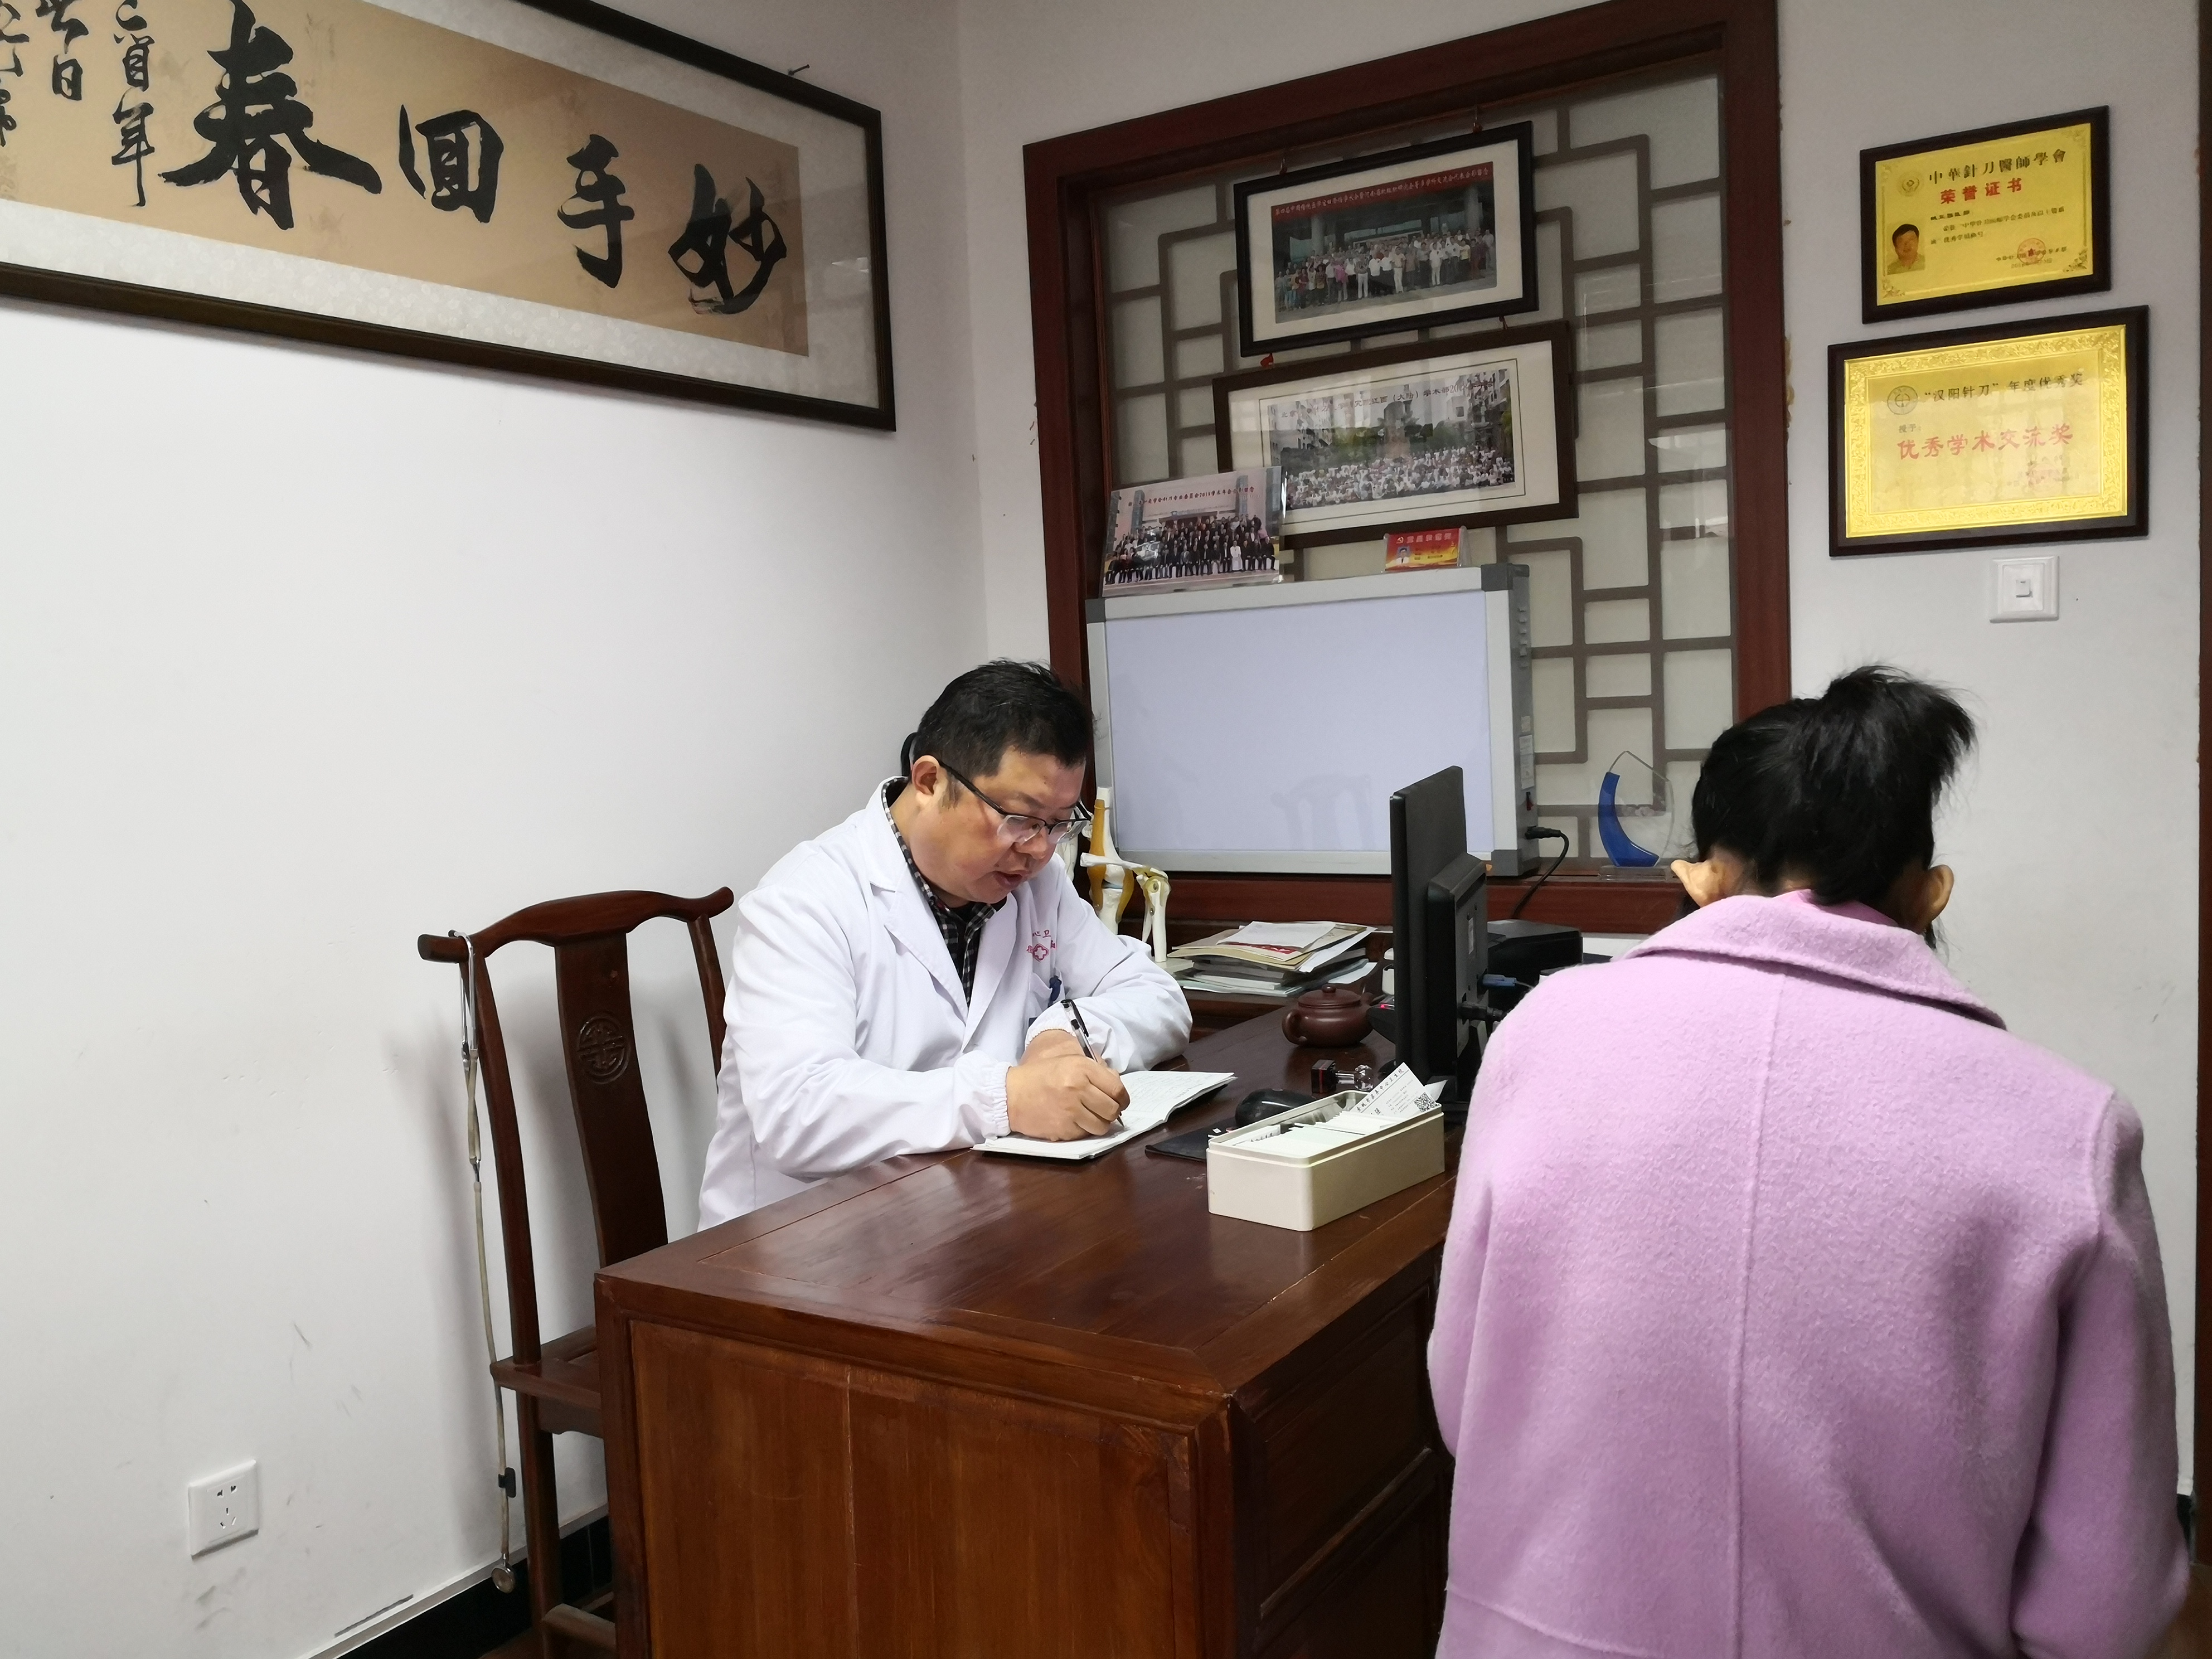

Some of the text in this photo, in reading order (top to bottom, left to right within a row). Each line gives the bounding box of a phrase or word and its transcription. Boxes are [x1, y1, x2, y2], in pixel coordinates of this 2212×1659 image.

[1929, 148, 2066, 184] 中華針刀醫師學會
[1940, 177, 2022, 204] 荣誉证书
[1897, 423, 2073, 460] 优秀学术交流奖
